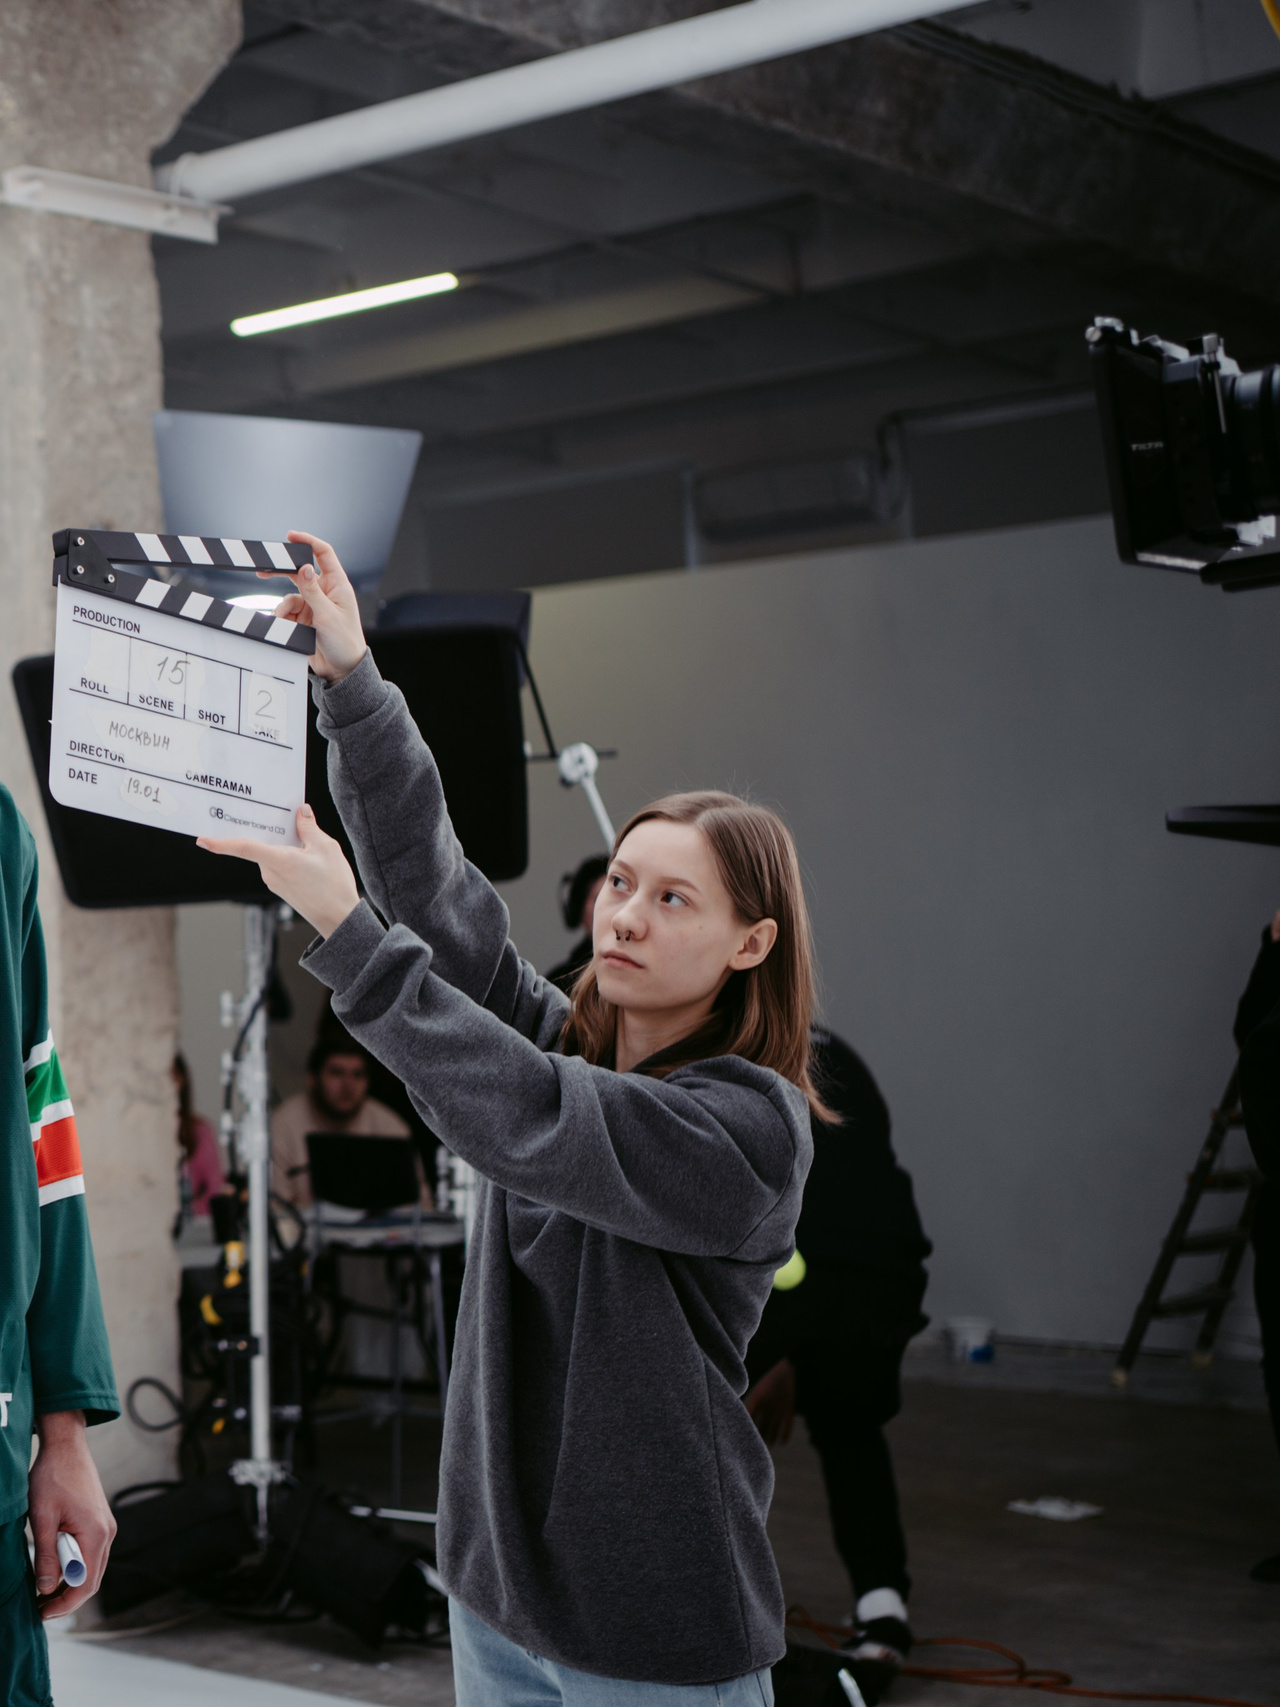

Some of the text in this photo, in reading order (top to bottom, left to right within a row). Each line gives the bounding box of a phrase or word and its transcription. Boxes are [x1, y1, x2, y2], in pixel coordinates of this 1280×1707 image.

[73, 605, 141, 634] PRODUCTION
[157, 656, 191, 685] 15
[80, 677, 109, 694] ROLL
[139, 694, 174, 711] SCENE
[255, 690, 276, 720] 2
[198, 709, 226, 725] SHOT
[109, 721, 170, 750] МОСКВИН
[69, 740, 125, 763] DIRECTOR
[68, 768, 98, 785] DATE
[185, 770, 252, 796] CAMERAMAN
[127, 777, 161, 803] 19.01
